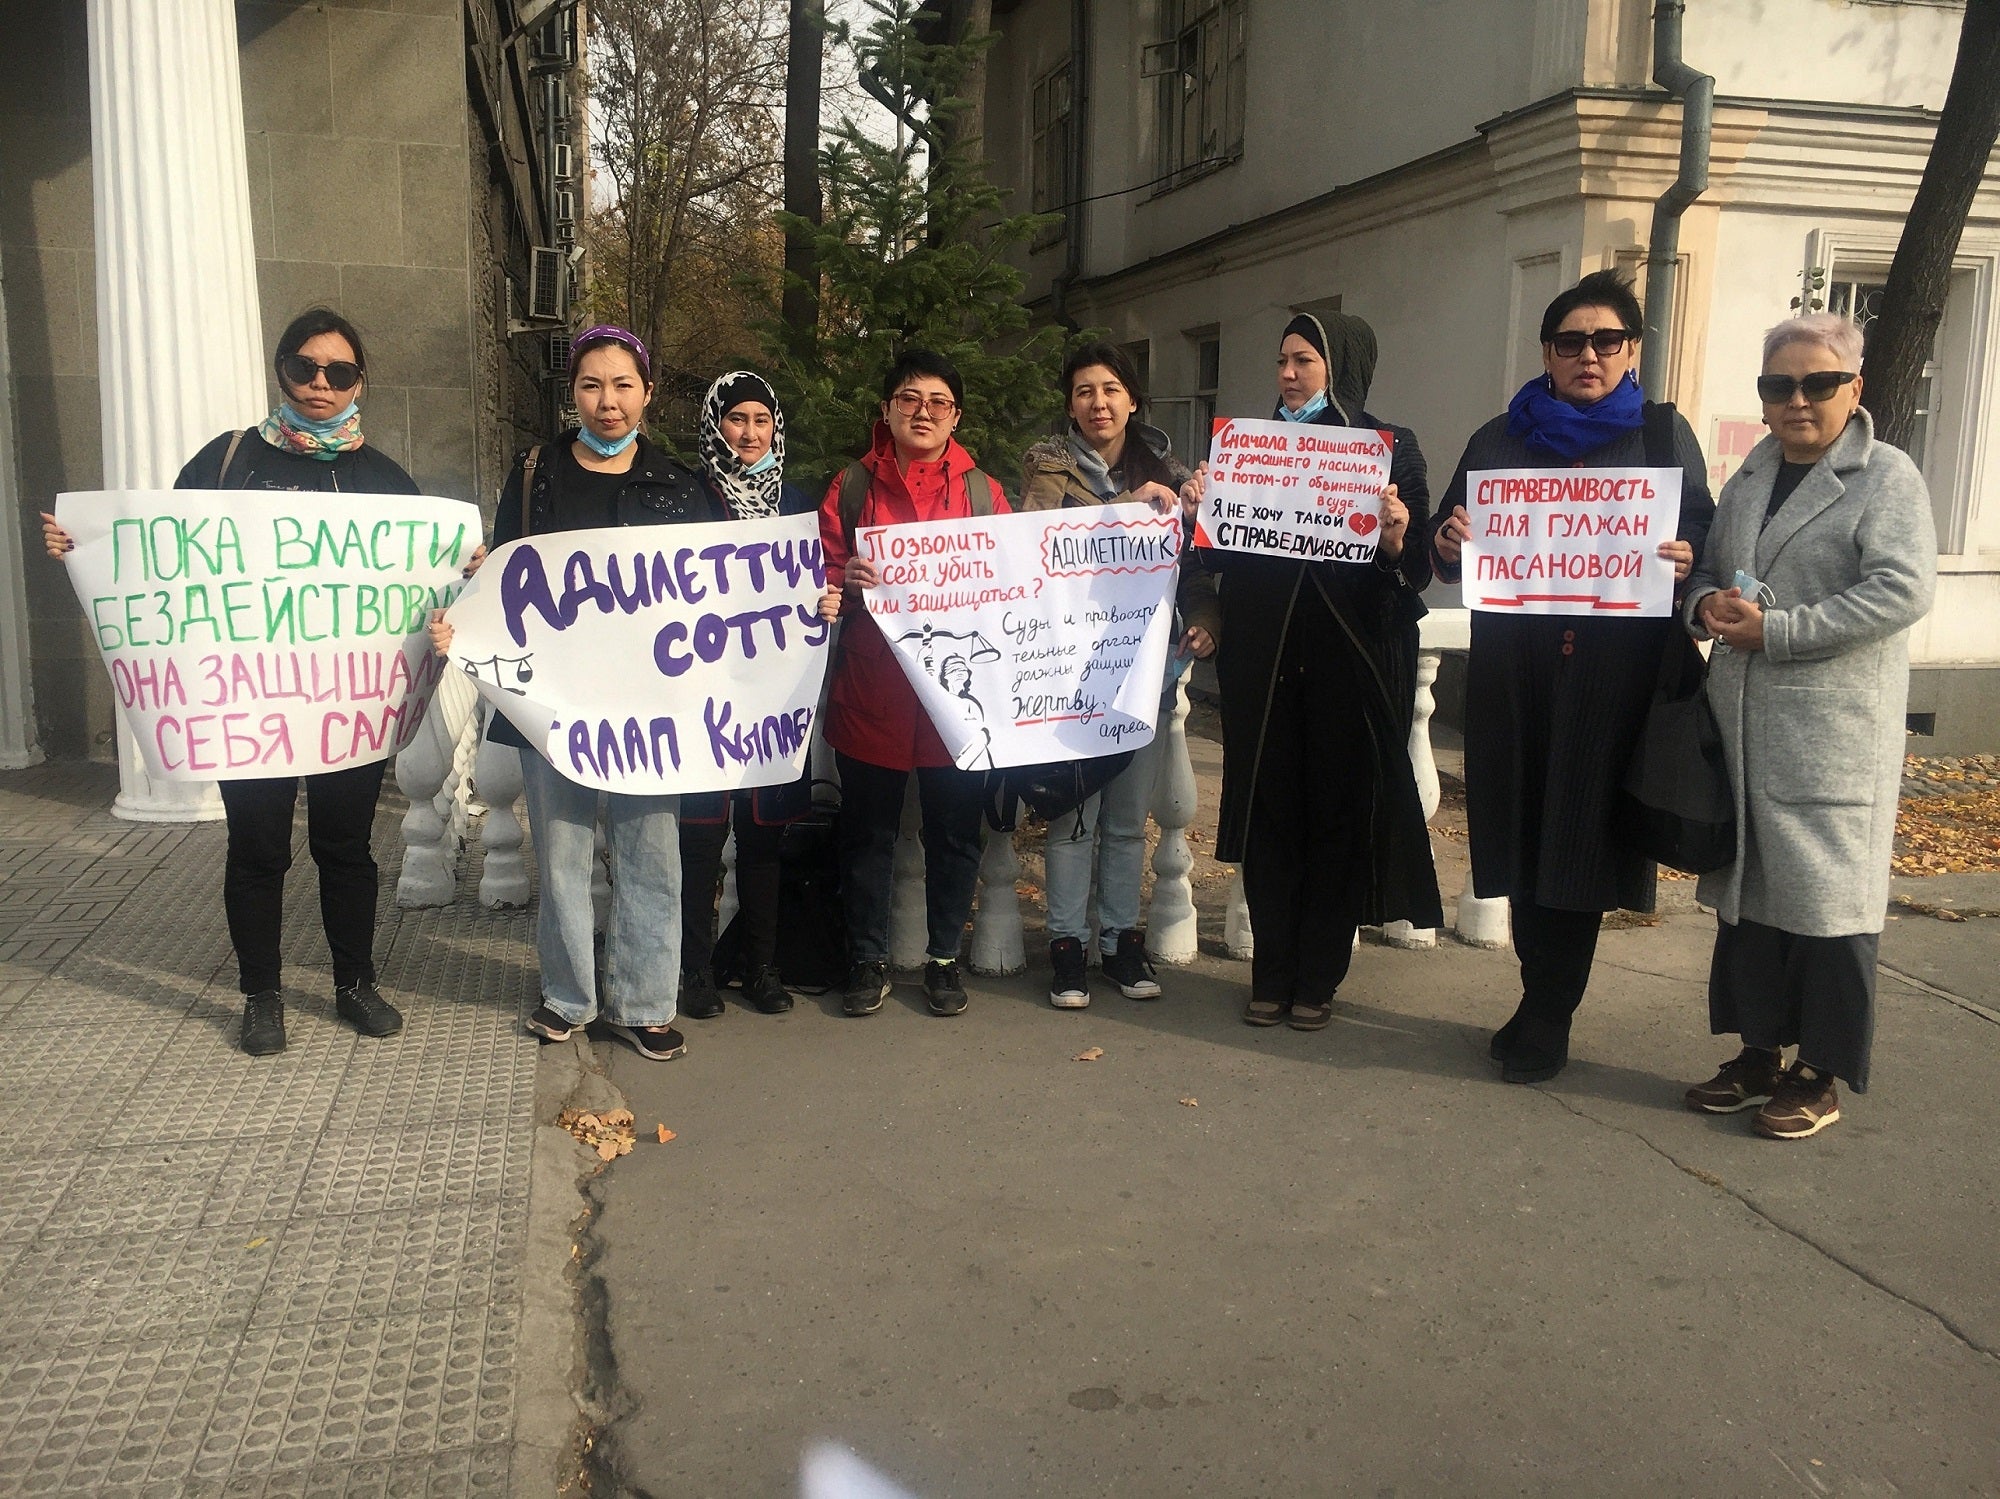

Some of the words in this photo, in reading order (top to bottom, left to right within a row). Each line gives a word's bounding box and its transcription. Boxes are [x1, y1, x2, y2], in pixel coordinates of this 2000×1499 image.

[1221, 424, 1287, 451] Сначала
[1297, 437, 1384, 457] защищаться
[1214, 471, 1225, 482] а
[1212, 498, 1223, 518] Я
[1227, 503, 1247, 518] НЕ
[1217, 522, 1376, 561] СПРАВЕДЛИВОСТИ
[1486, 513, 1529, 537] ДЛЯ
[1548, 513, 1649, 538] ГУЛЖАН
[112, 516, 246, 584] ПОКА
[273, 516, 466, 572] ВЛАСТИ
[863, 528, 996, 563] Позволить
[882, 559, 929, 586] себя
[933, 556, 995, 588] убить
[1478, 550, 1643, 580] ПАСАНОВОЙ
[869, 599, 901, 615] или
[653, 603, 829, 677] СОТТУ
[1002, 611, 1051, 645] Суды
[1063, 614, 1076, 625] и
[1012, 644, 1077, 663] тельные
[1091, 635, 1142, 656] орган
[112, 657, 188, 711] ОНА
[1011, 664, 1074, 693] должны
[155, 713, 294, 772] СЕБЯ
[321, 697, 427, 765] САМА
[548, 716, 682, 782] АЛАП
